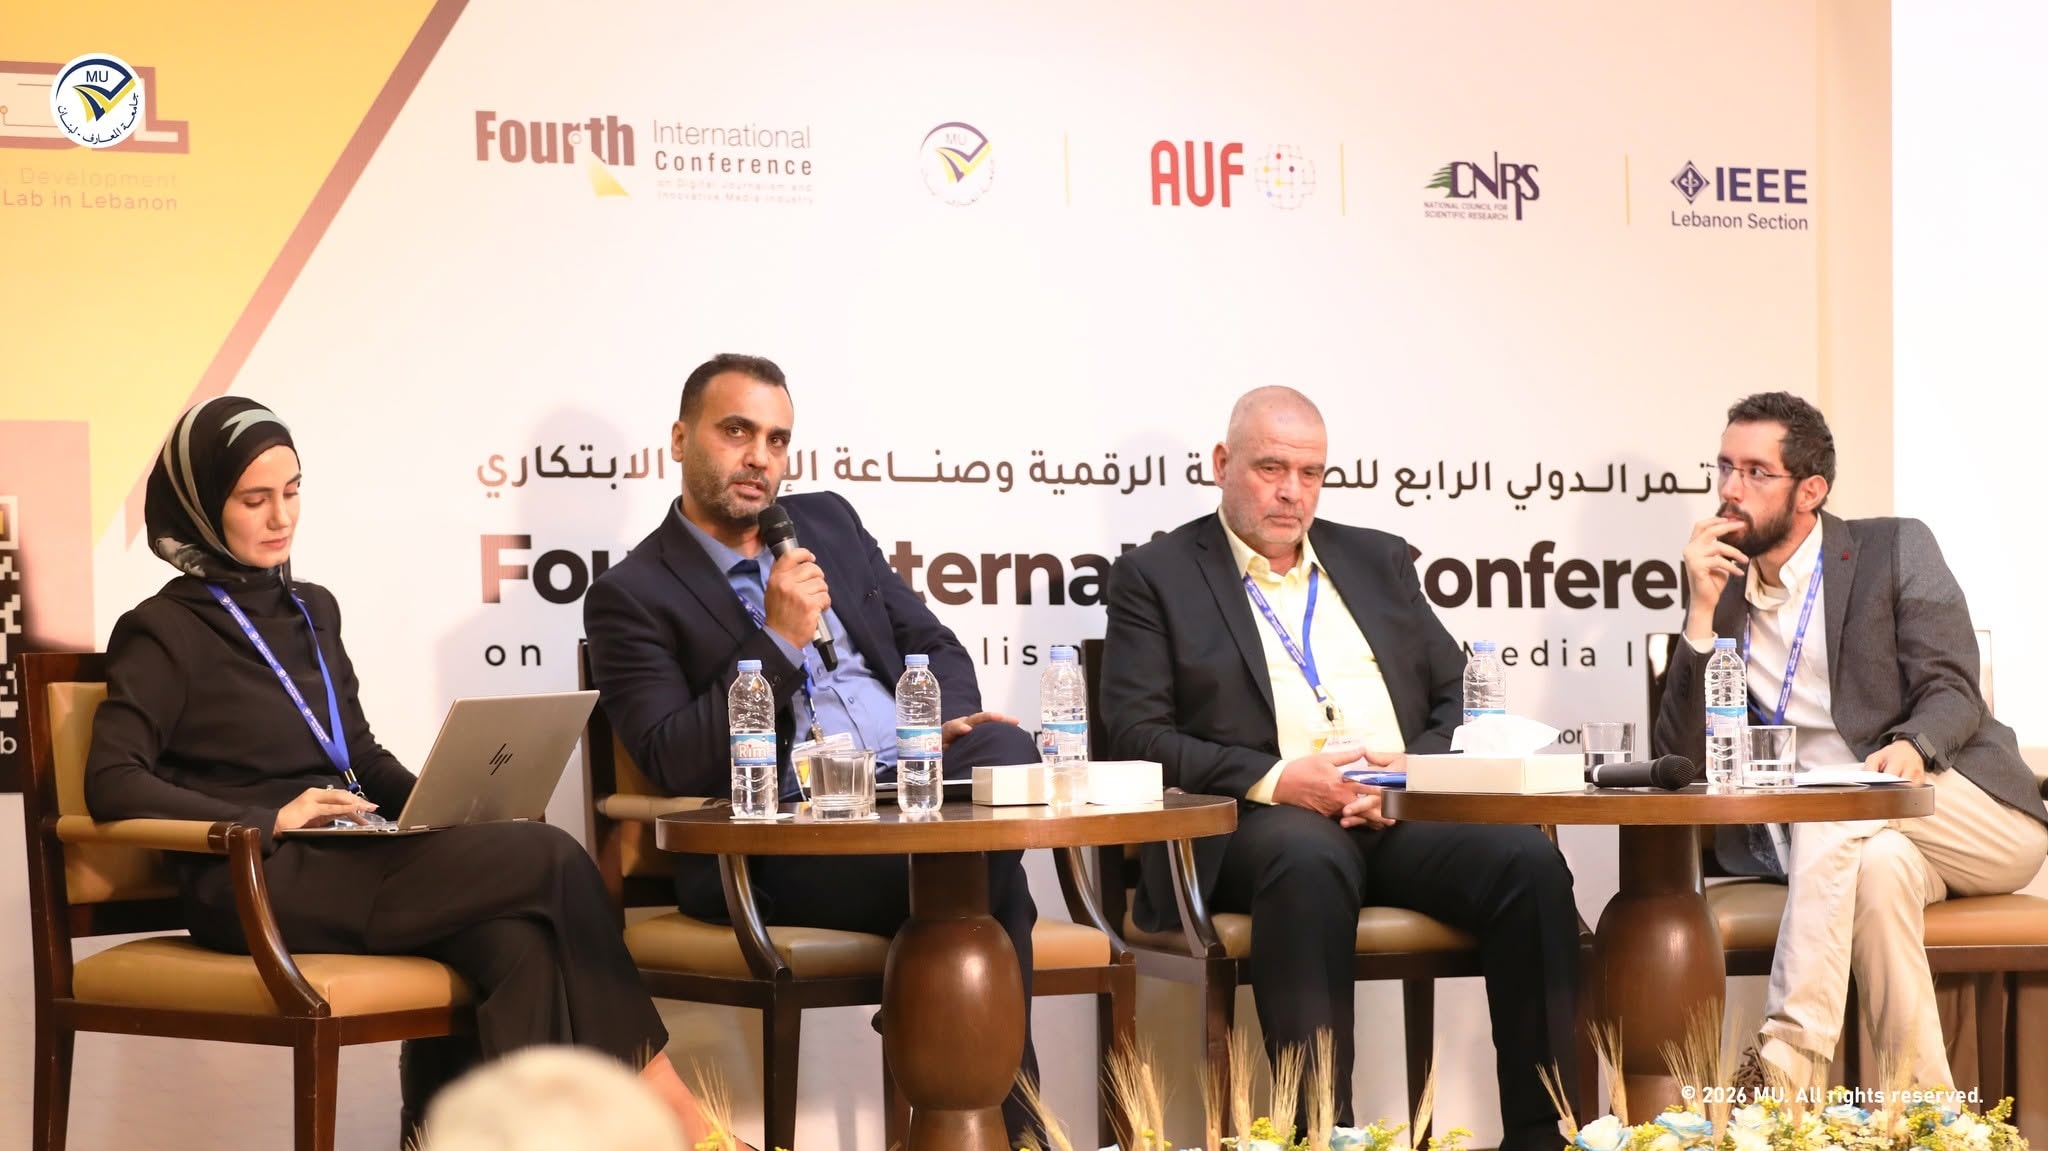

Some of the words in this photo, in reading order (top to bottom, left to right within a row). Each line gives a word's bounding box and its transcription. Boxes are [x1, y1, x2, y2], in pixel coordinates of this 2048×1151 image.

[475, 111, 635, 166] Fourth
[653, 120, 811, 149] International
[655, 151, 812, 176] Conference
[1150, 140, 1245, 208] AUF
[3, 190, 43, 207] Lab
[53, 191, 72, 208] in
[81, 192, 177, 211] Lebanon
[1449, 151, 1541, 221] CNRS
[1715, 167, 1808, 205] IEEE
[1424, 202, 1458, 210] NATIONAL
[1468, 212, 1508, 220] RESEARCH
[1672, 211, 1743, 229] Lebanon
[1748, 213, 1809, 232] Section
[477, 444, 665, 499] الابتكاري
[1029, 449, 1167, 496] الرقمية
[1394, 461, 1492, 507] الرابع
[485, 644, 542, 667] on
